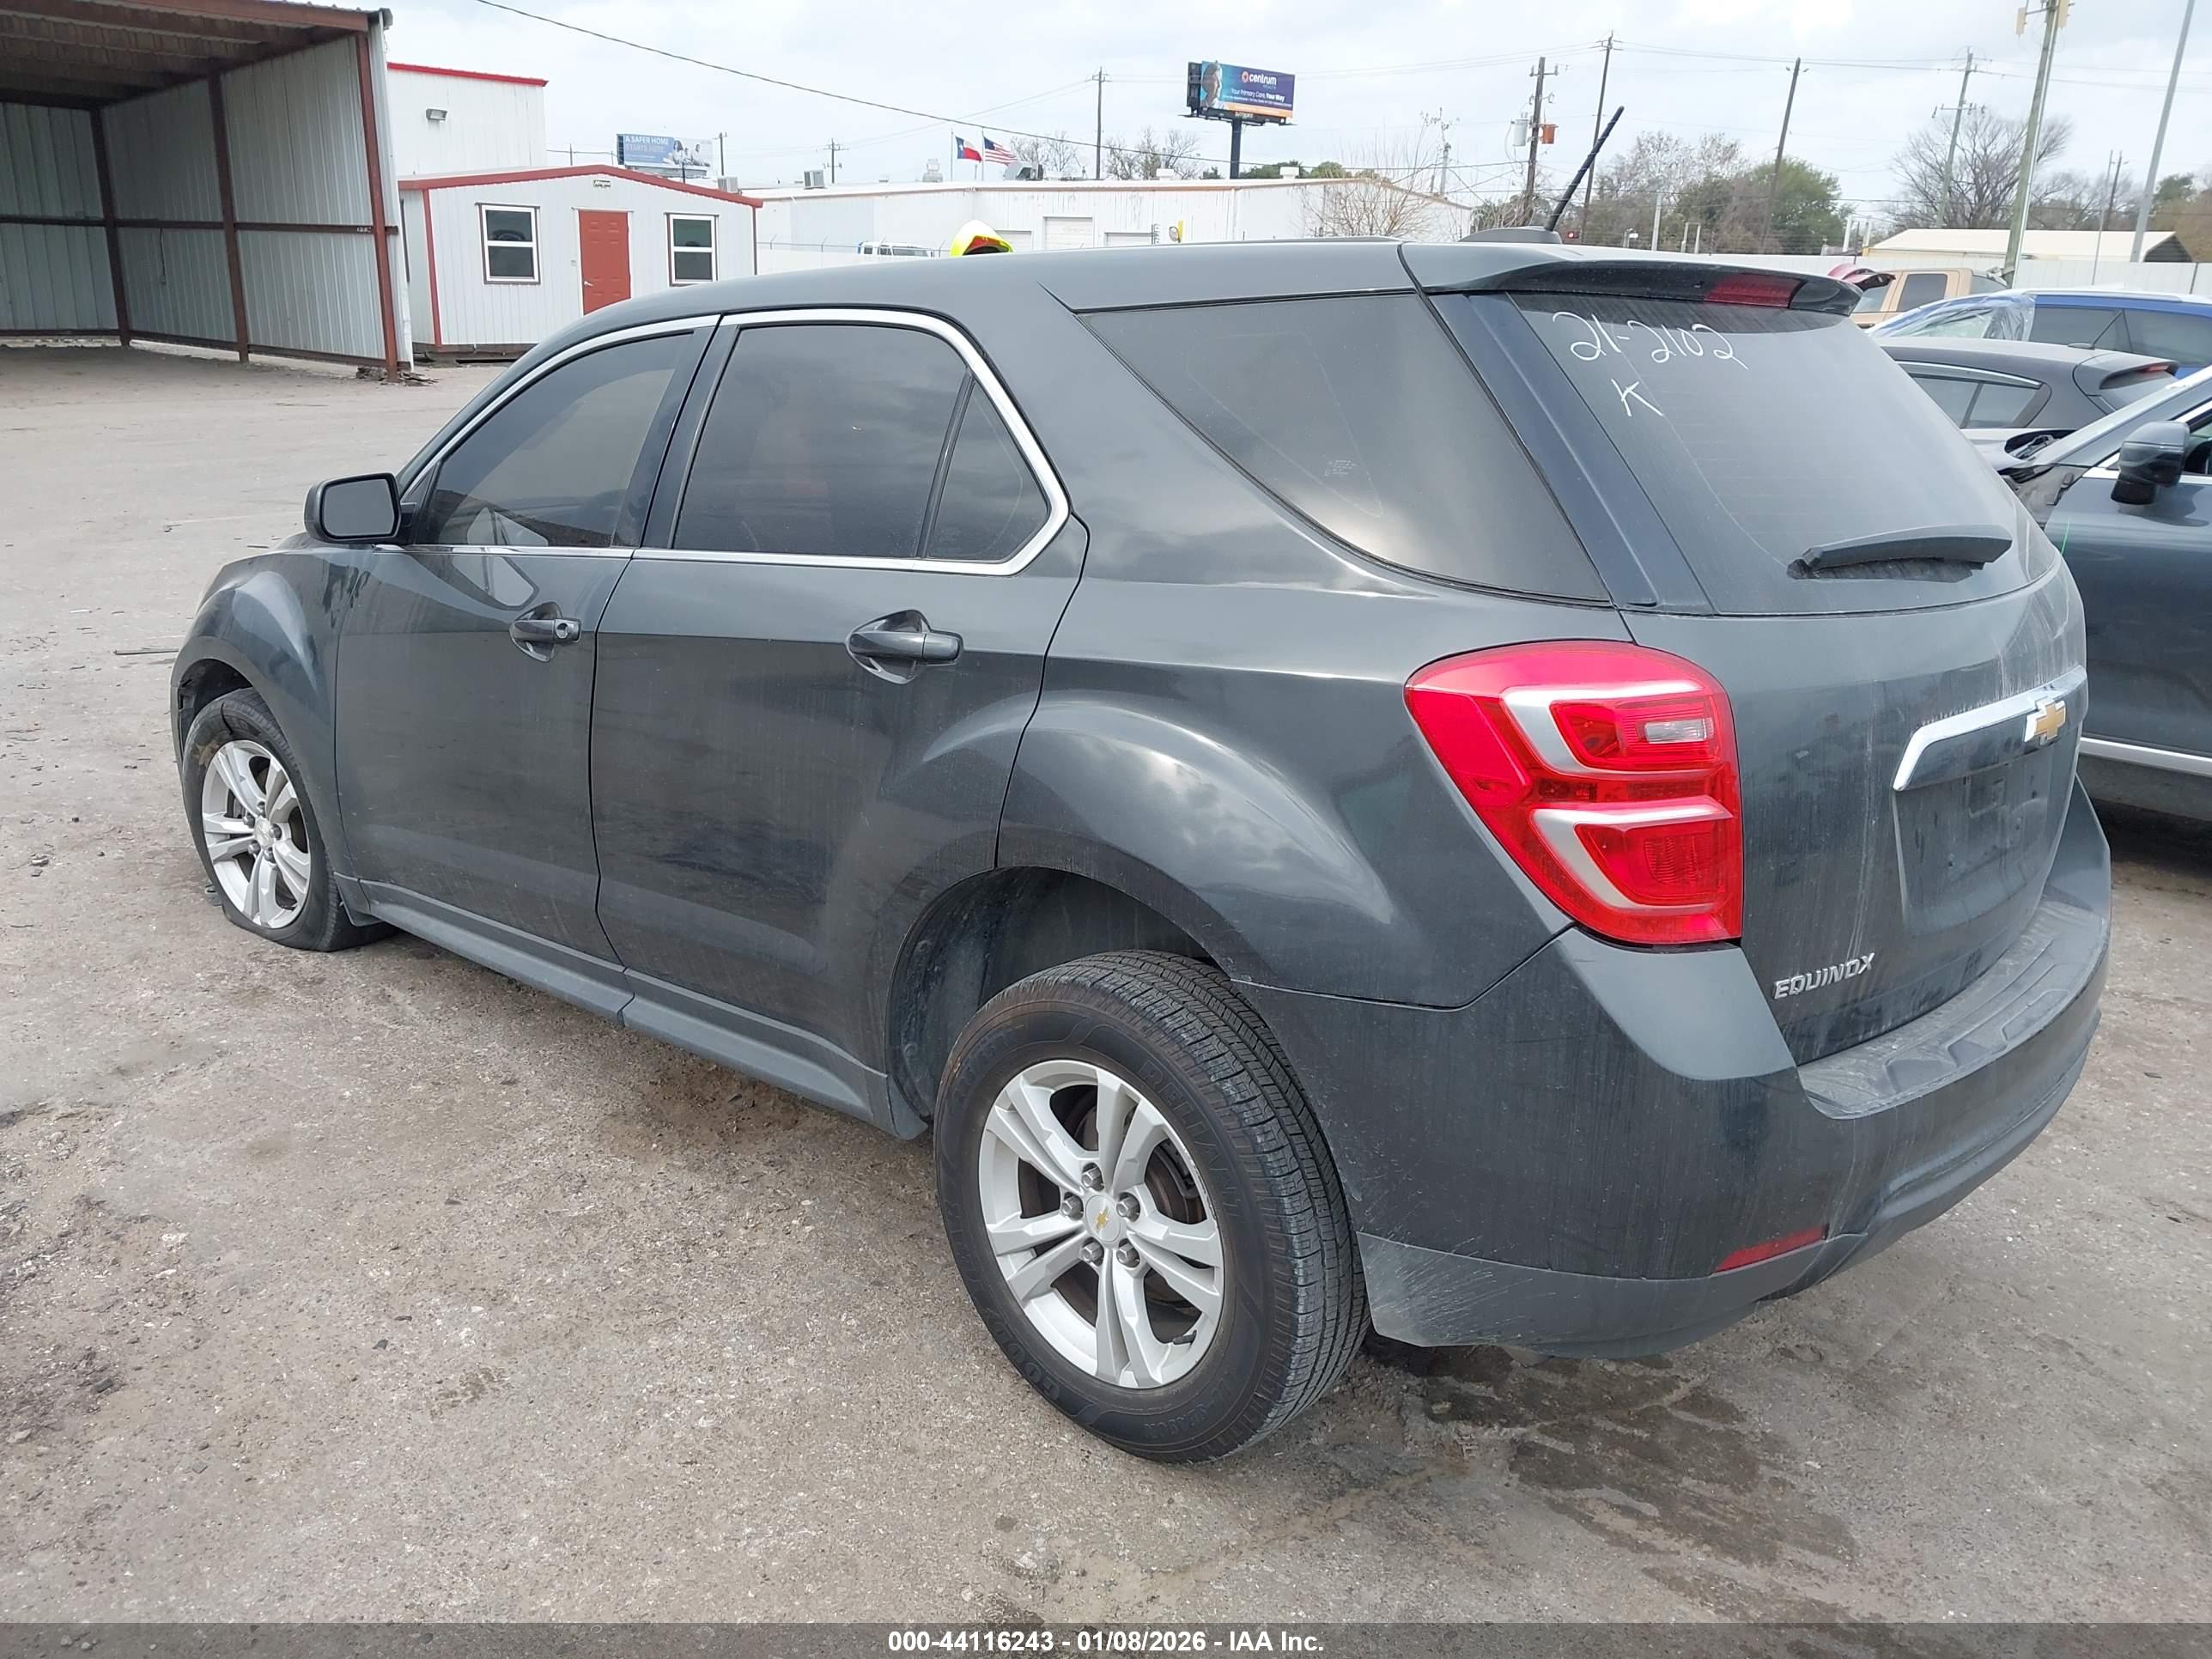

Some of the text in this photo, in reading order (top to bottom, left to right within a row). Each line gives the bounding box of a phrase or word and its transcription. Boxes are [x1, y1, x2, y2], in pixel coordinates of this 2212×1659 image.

[1249, 73, 1277, 85] centrum
[1553, 311, 1748, 369] 21-2102
[1611, 379, 1664, 416] K
[1773, 952, 1875, 1000] EQUINOX
